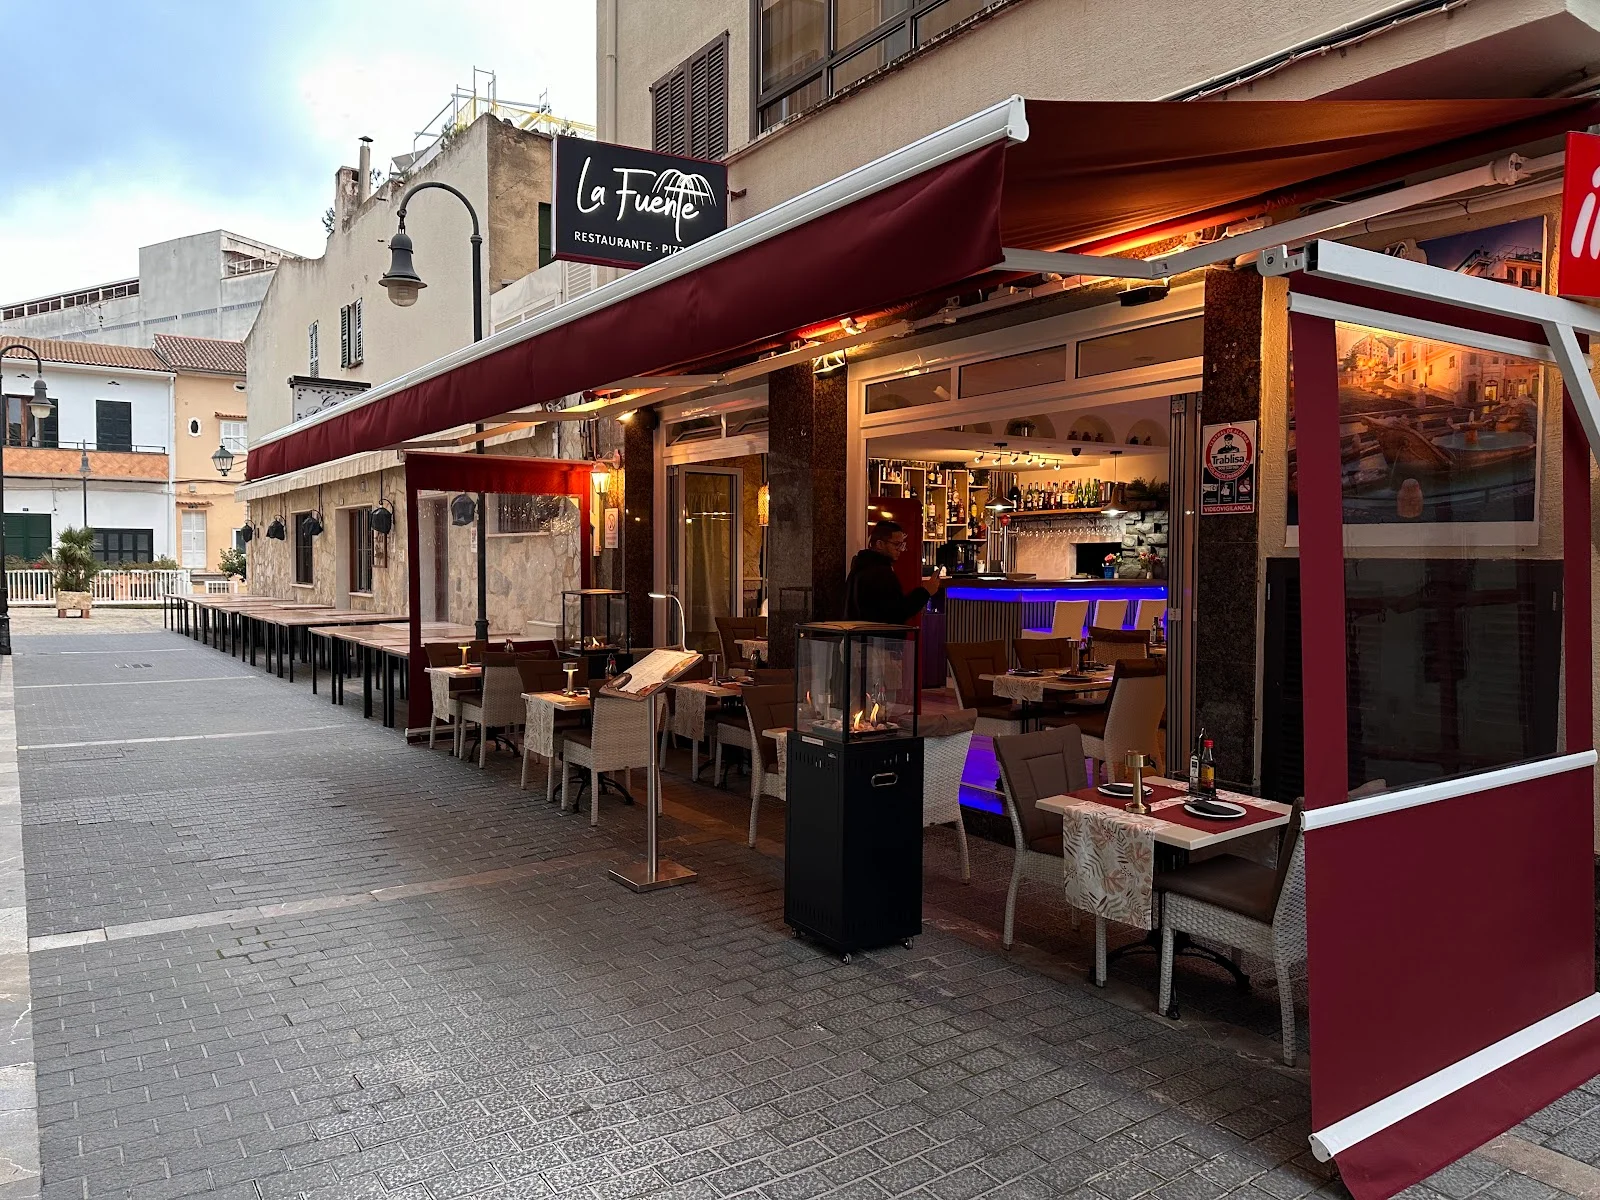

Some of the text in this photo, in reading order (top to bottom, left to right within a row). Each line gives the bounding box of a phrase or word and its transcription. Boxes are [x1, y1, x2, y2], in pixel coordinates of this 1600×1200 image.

[577, 156, 706, 242] La Fuente
[574, 231, 652, 252] RESTAURANTE
[1212, 454, 1245, 465] Trablisa
